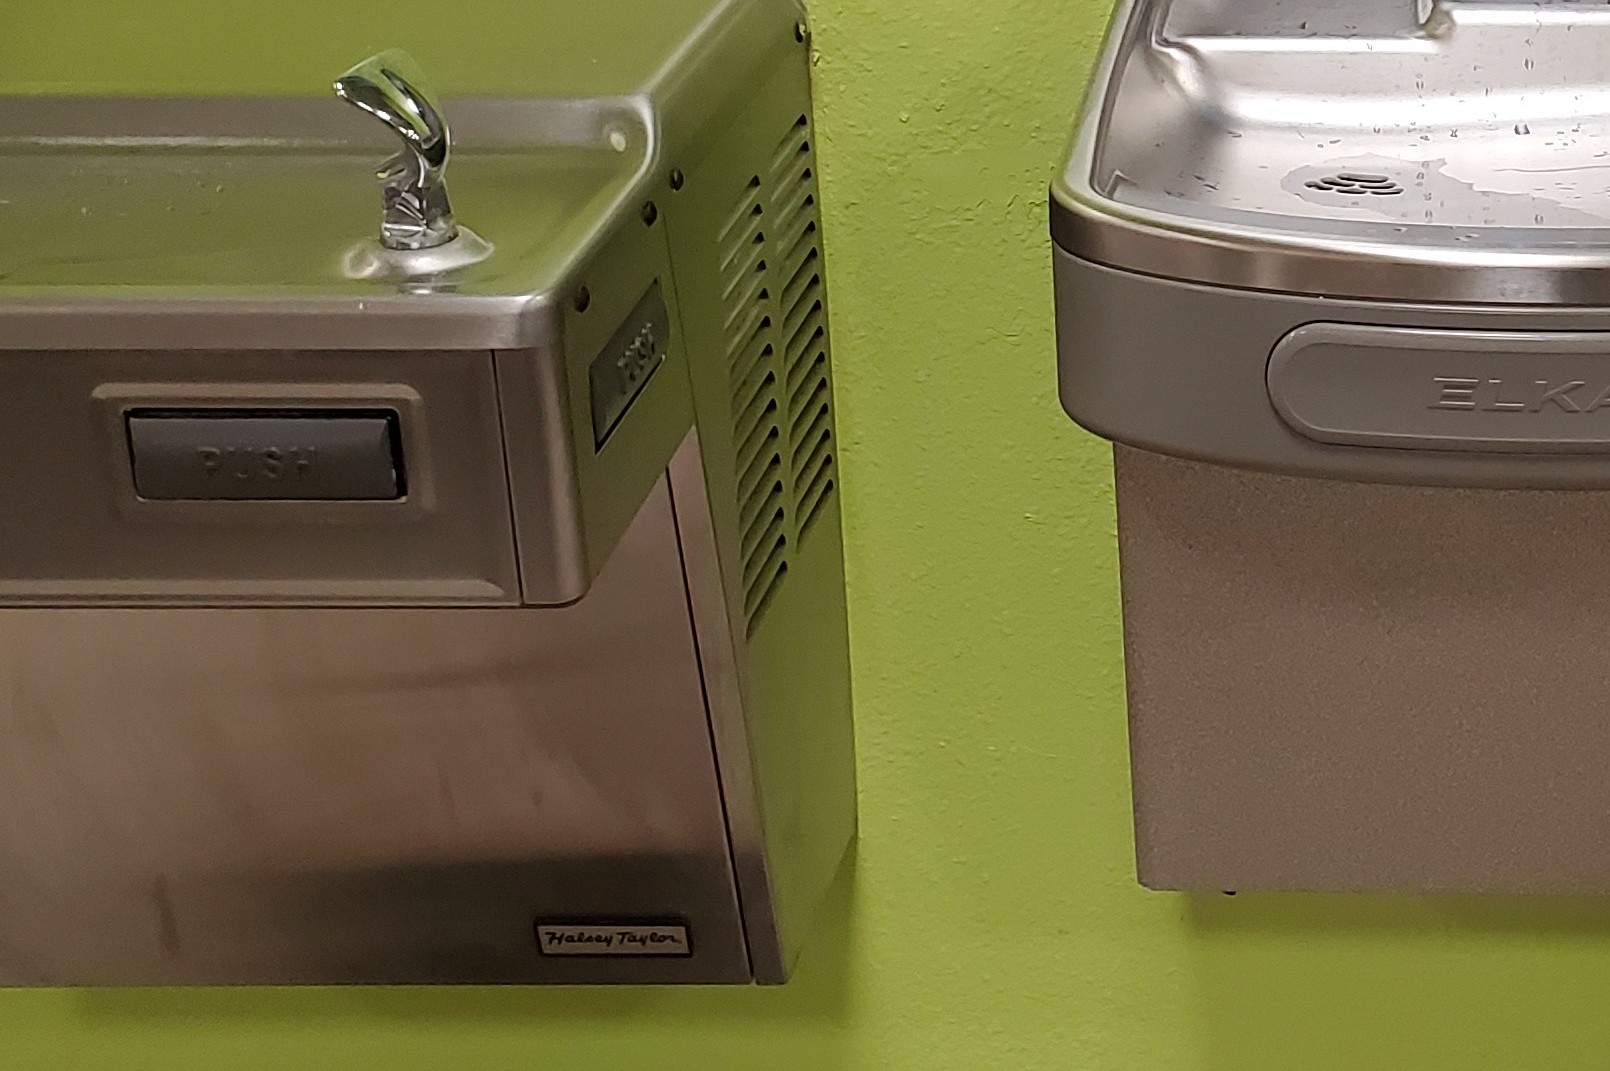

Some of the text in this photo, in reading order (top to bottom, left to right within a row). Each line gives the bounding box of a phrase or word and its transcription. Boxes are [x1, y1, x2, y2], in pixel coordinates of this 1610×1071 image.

[196, 445, 320, 480] PUSH
[544, 931, 680, 947] Halsey Taylor
